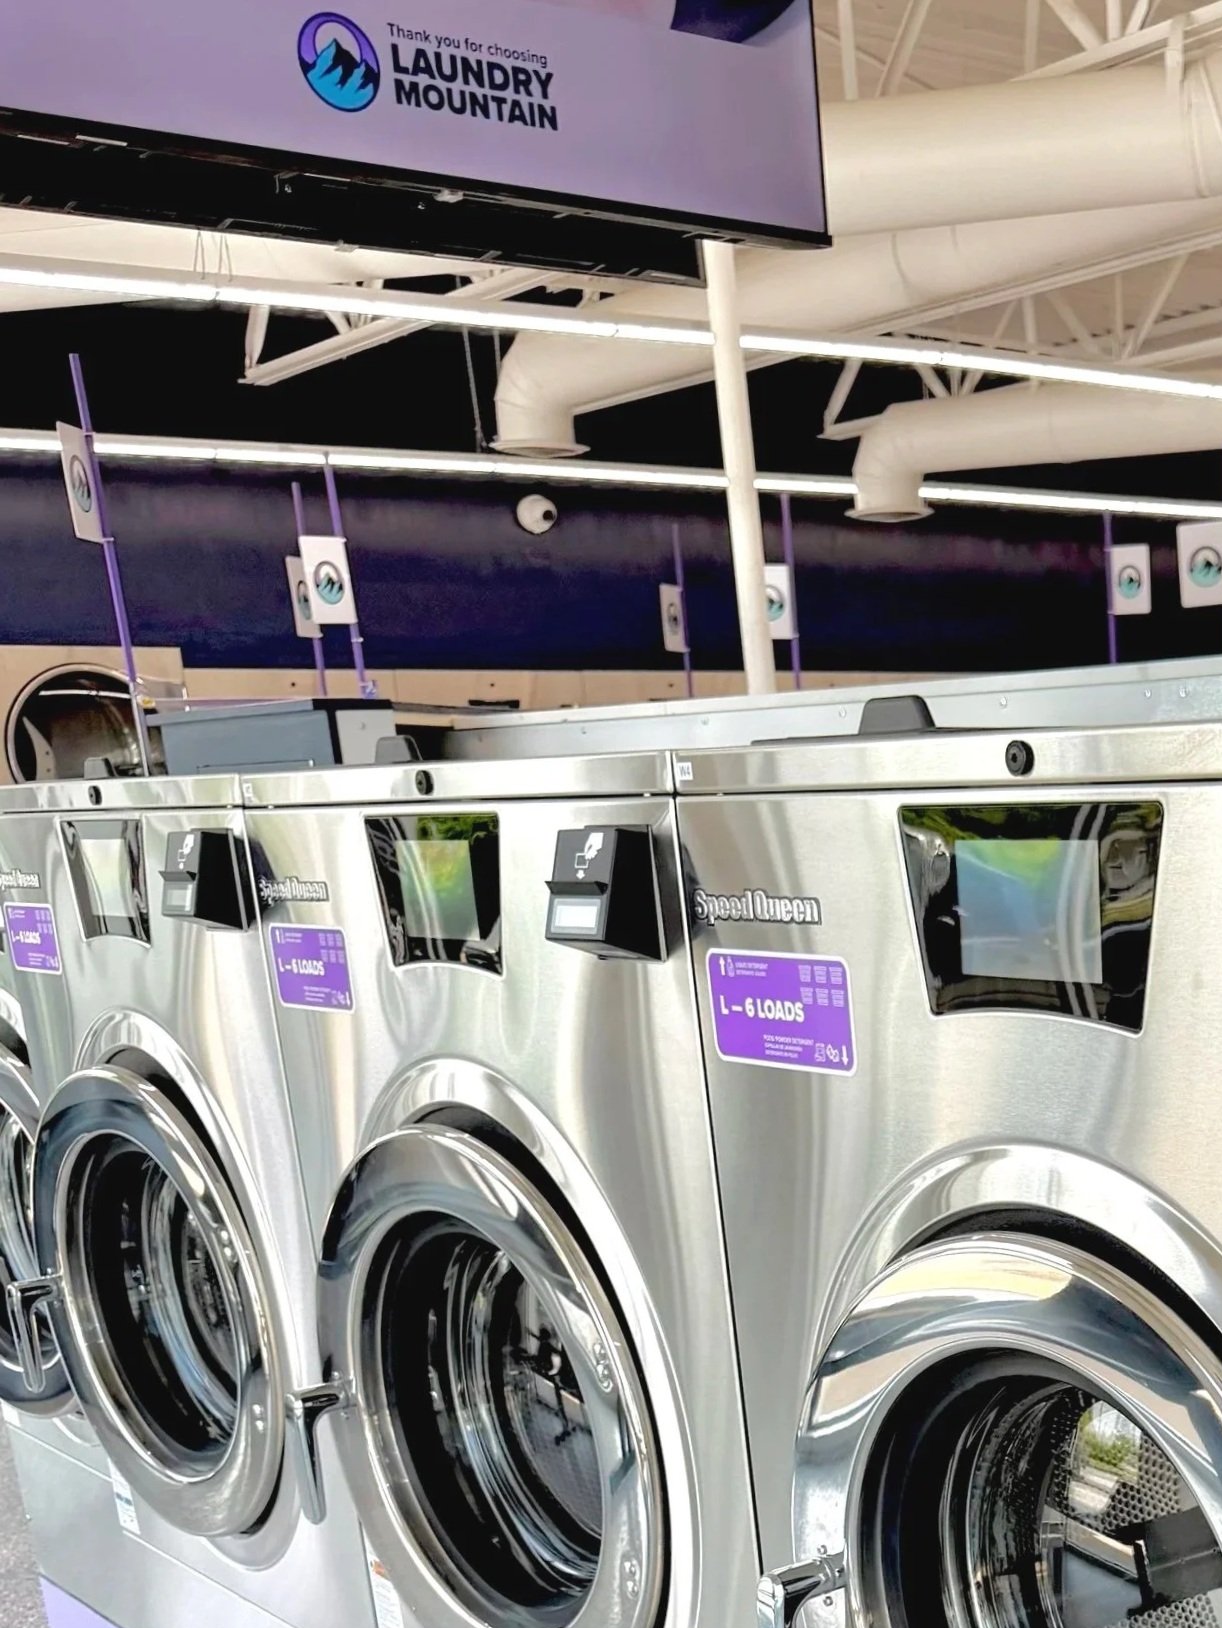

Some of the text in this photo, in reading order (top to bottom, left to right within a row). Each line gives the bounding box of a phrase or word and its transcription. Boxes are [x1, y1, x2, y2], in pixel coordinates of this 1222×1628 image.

[386, 22, 548, 68] Thank you for choosing
[391, 43, 554, 100] LAUNDRY
[394, 78, 559, 131] MOUNTAIN
[693, 888, 822, 926] Speed Queen
[299, 959, 325, 976] LOADS
[720, 995, 729, 1015] L
[745, 997, 755, 1018] 6
[756, 998, 805, 1023] LOADS
